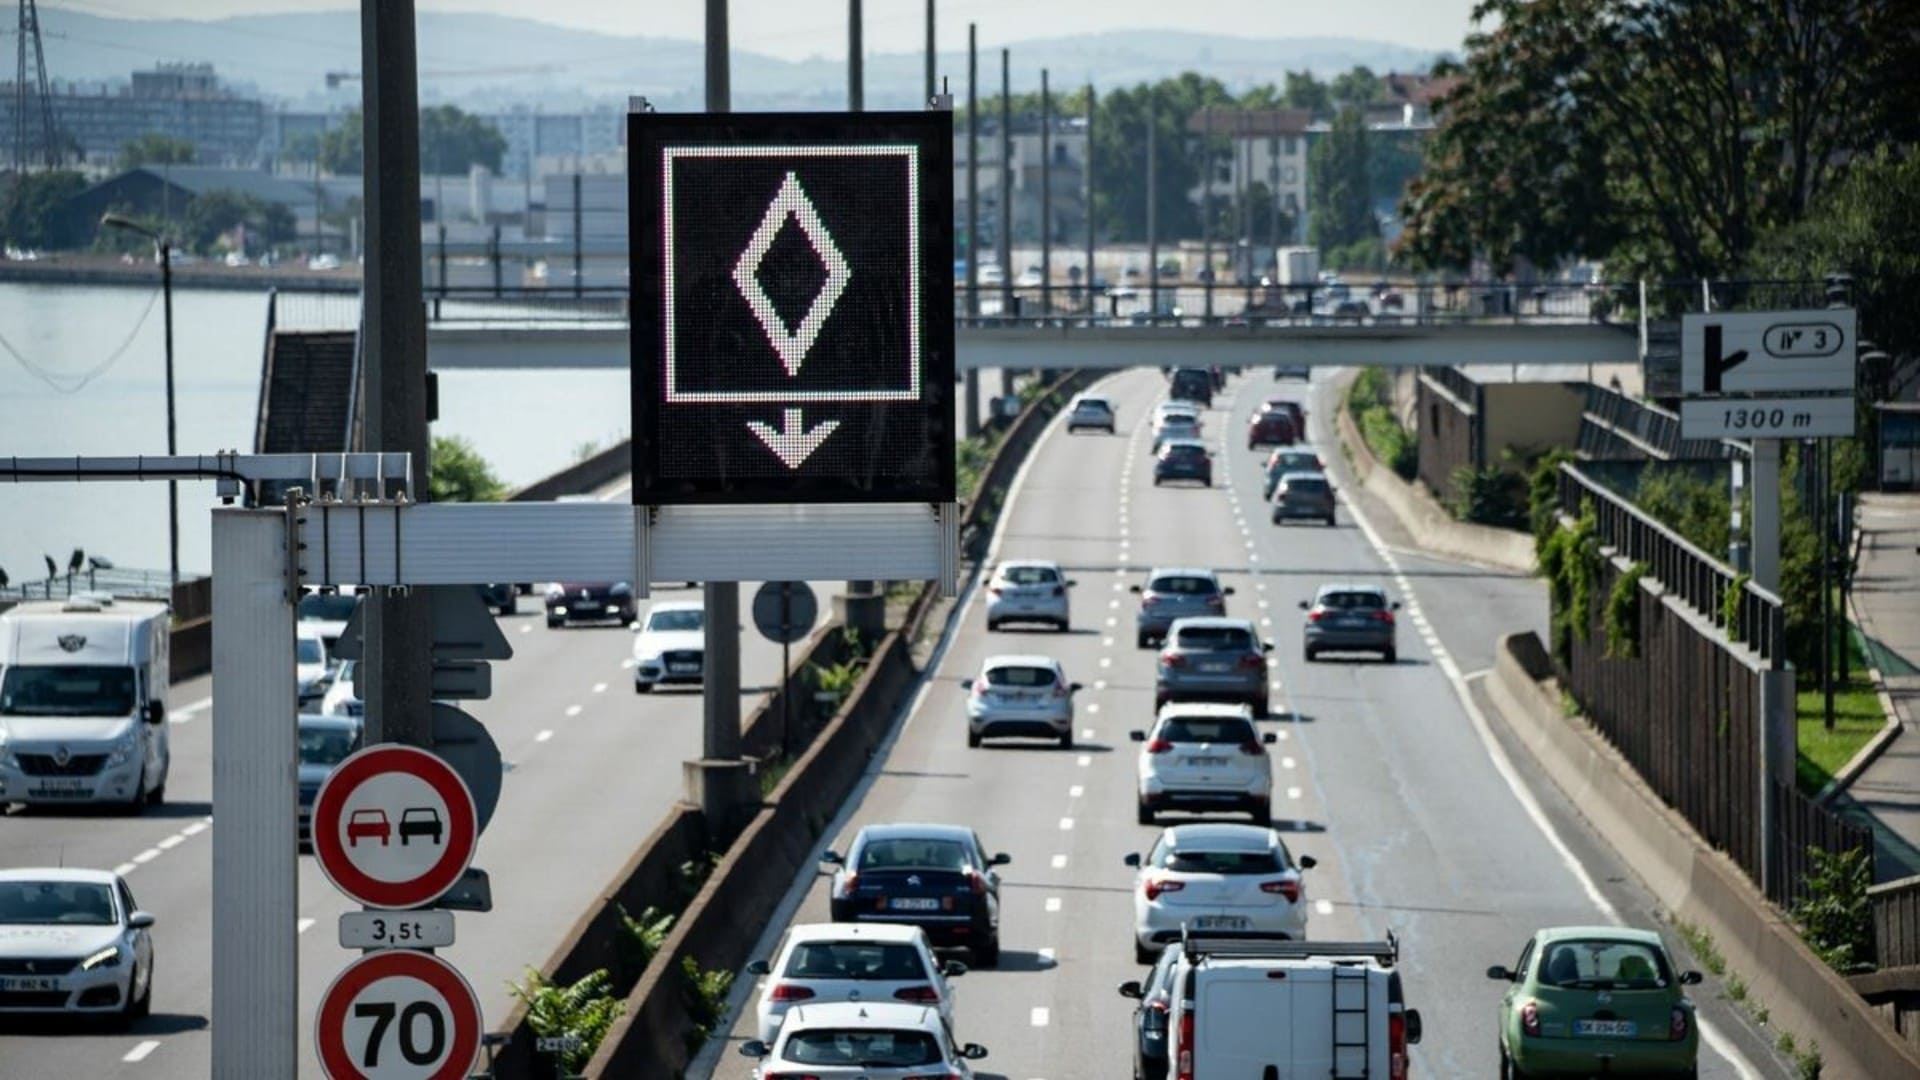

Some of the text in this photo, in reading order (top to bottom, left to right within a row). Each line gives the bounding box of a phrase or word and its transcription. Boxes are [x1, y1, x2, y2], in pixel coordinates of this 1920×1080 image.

[1814, 330, 1826, 349] 3
[1724, 408, 1811, 429] 1300 m
[354, 1001, 445, 1067] 70
